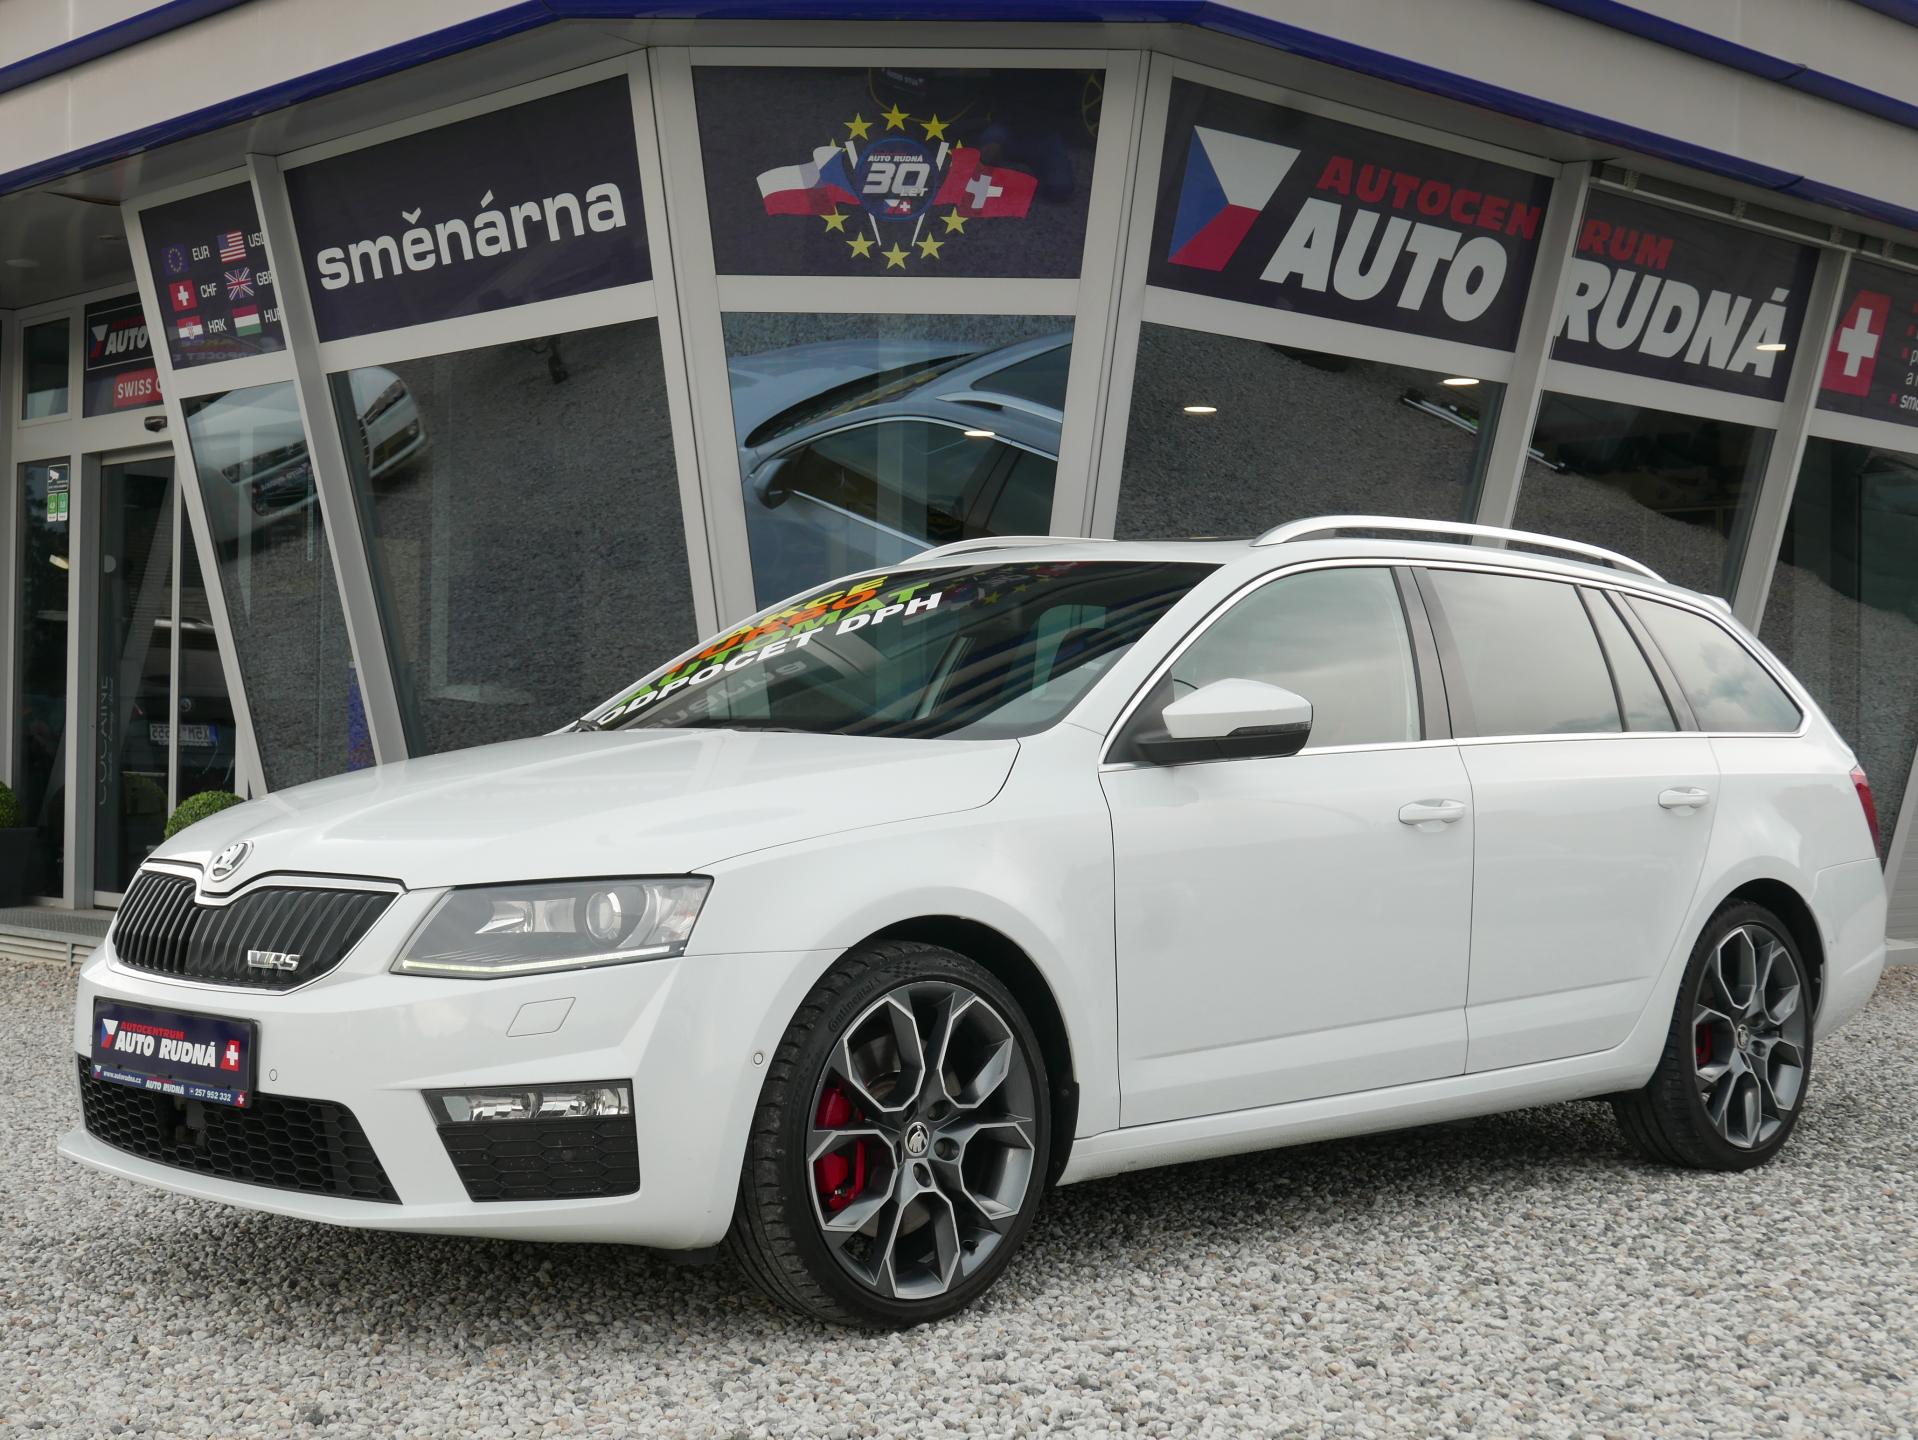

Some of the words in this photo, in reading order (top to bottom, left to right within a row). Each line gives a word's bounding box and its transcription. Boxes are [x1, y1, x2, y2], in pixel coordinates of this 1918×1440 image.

[893, 154, 923, 162] RUDNÁ
[862, 162, 931, 194] 30
[316, 182, 627, 291] směnárna
[192, 245, 211, 262] EUR
[200, 282, 217, 298] CHF
[1259, 197, 1508, 322] AUTO
[1553, 256, 1790, 379] RUDNÁ
[207, 318, 227, 335] HRK
[105, 325, 149, 356] AUTO
[117, 378, 152, 399] SWISS
[597, 627, 824, 726] ODPOCET
[835, 591, 943, 637] DPH
[120, 1021, 184, 1041] AUTOCENTRUM
[114, 1030, 155, 1057] AUTO
[158, 1038, 216, 1068] RUDNÁ
[145, 1079, 162, 1091] AUTO
[194, 1088, 206, 1097] 257
[206, 1090, 219, 1099] 952
[219, 1092, 232, 1102] 332
